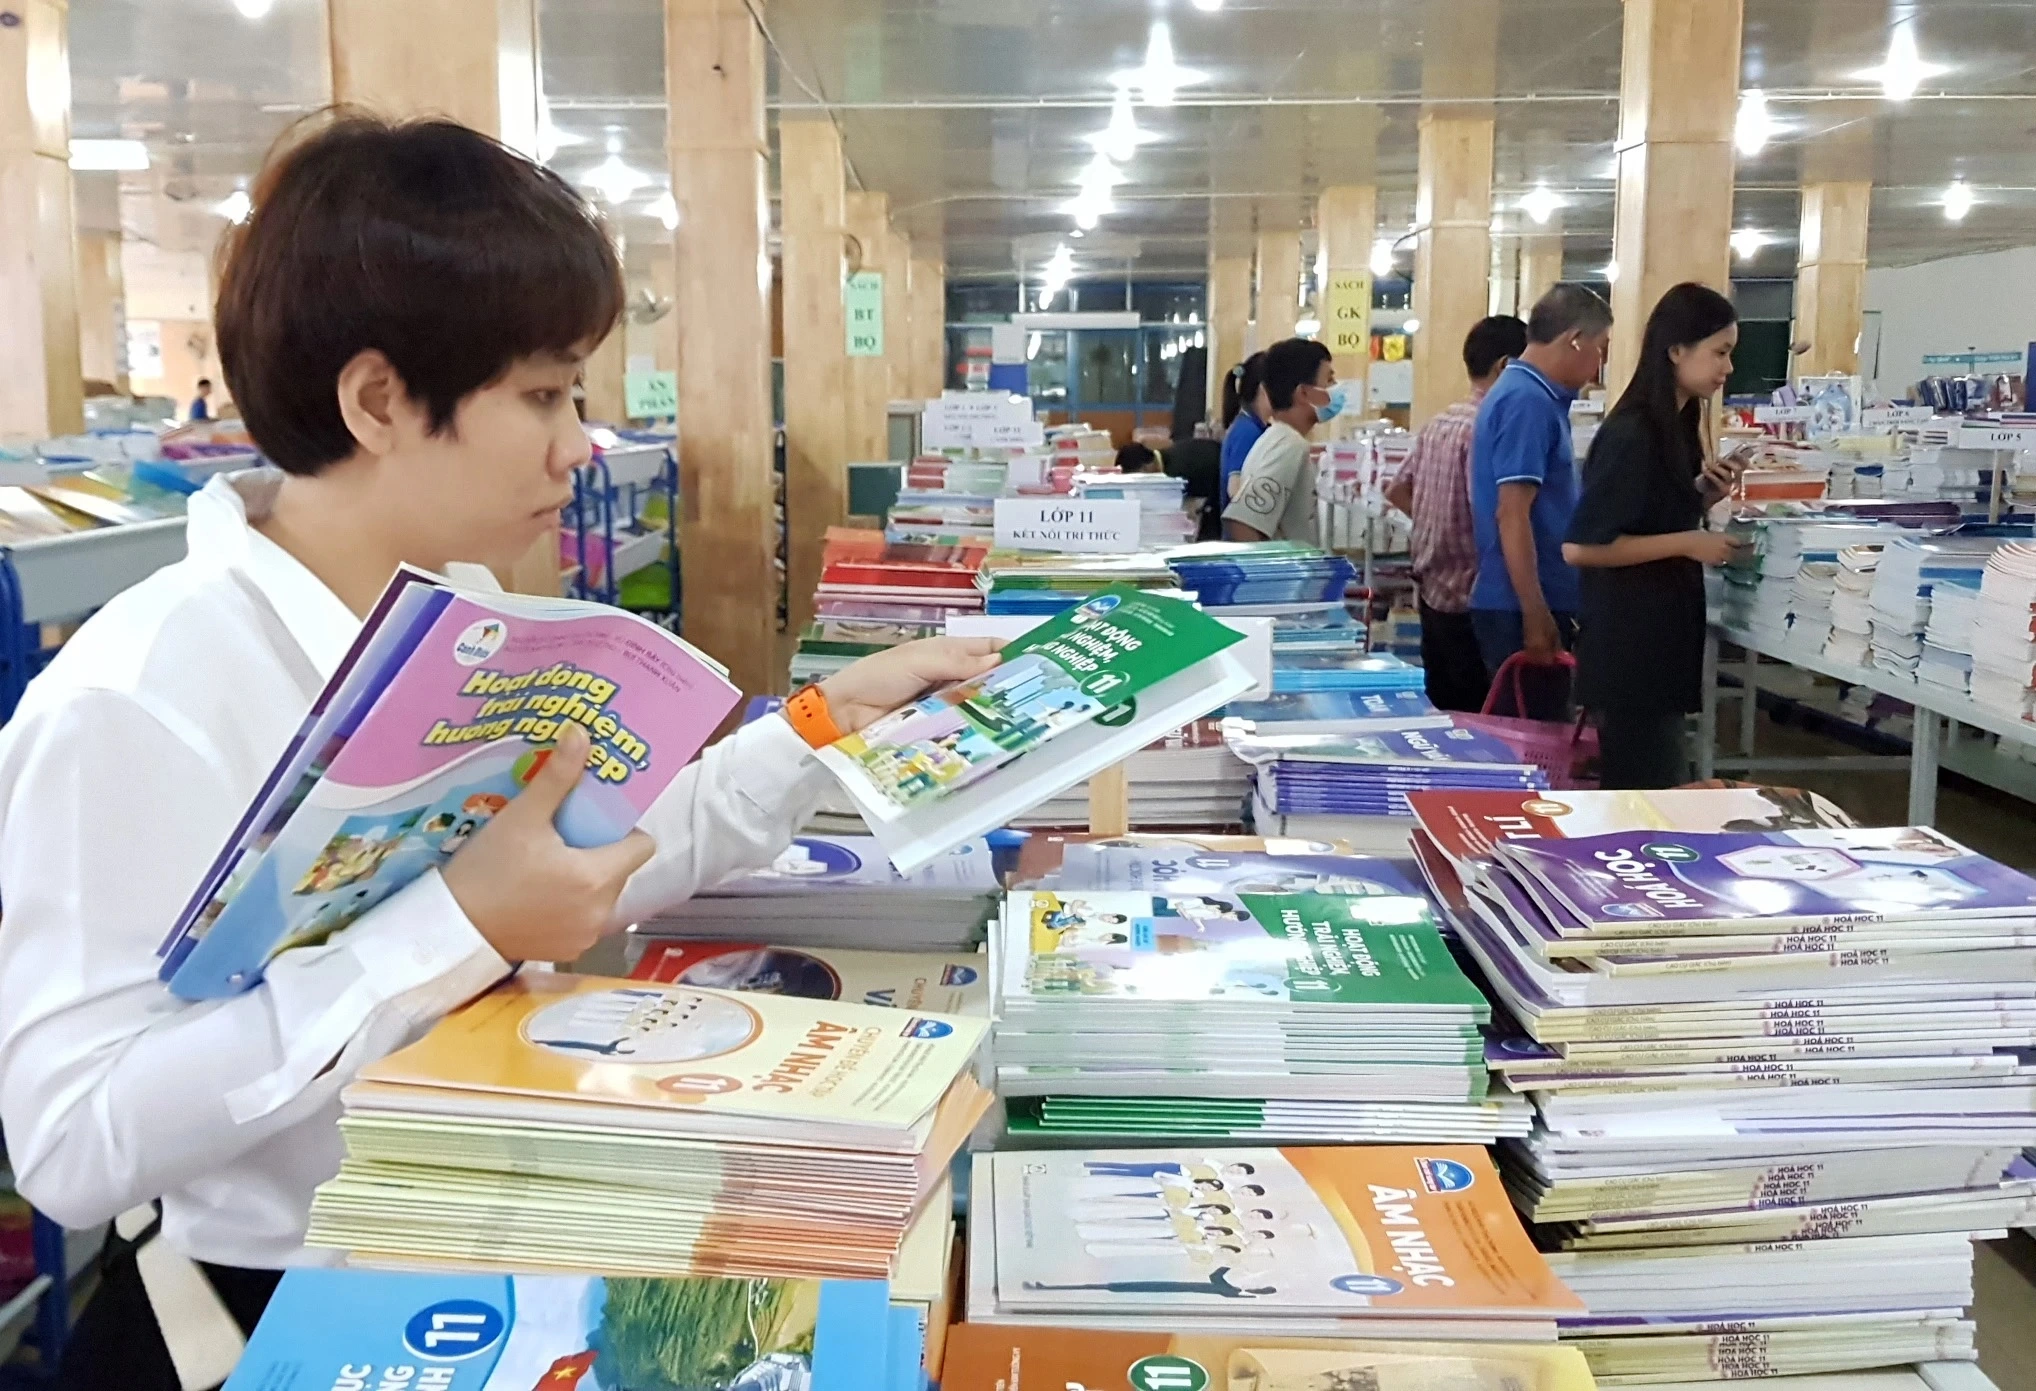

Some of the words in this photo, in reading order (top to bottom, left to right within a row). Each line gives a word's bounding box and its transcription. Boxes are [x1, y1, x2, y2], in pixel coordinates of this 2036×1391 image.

[1337, 306, 1361, 319] GK
[1338, 331, 1360, 349] BỘ
[2016, 433, 2022, 441] 5
[1040, 506, 1074, 523] LỚP
[1080, 511, 1093, 523] 11
[1013, 529, 1036, 539] KẾT
[1040, 529, 1062, 539] NỐI
[1089, 530, 1121, 541] THỨC
[462, 669, 539, 696] Hoạt
[1086, 674, 1123, 694] 11
[513, 717, 629, 782] ngệp
[1530, 803, 1560, 814] 11
[1649, 846, 1691, 859] 11
[1196, 858, 1230, 868] 11
[1594, 848, 1661, 883] HỌC
[1623, 880, 1704, 909] HOÁ
[1341, 928, 1369, 953] HOẠT
[1293, 979, 1331, 990] 11
[797, 1019, 858, 1050] ÂM
[752, 1051, 828, 1094] NHẠC
[672, 1076, 729, 1092] 11
[1367, 1184, 1420, 1226] ÂM
[1385, 1230, 1455, 1288] NHẠC
[1346, 1278, 1392, 1292] 11
[424, 1313, 487, 1348] 11
[1143, 1365, 1192, 1390] 11
